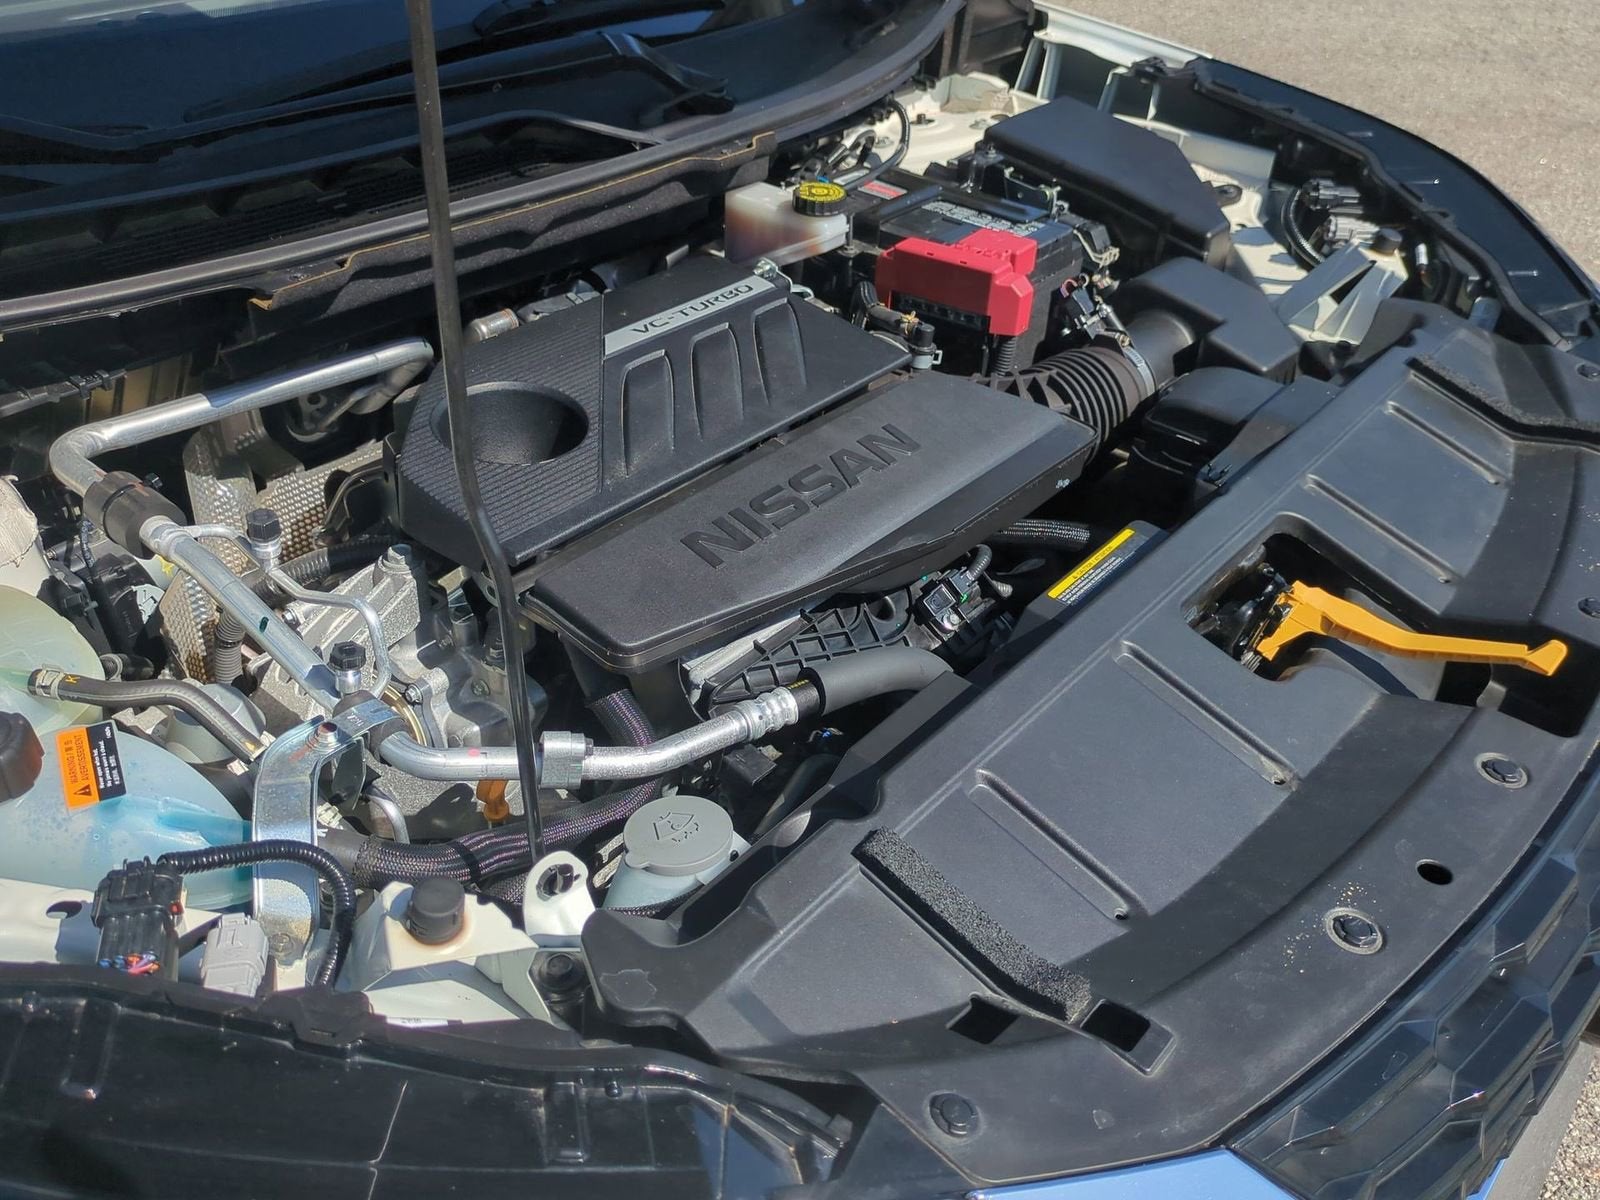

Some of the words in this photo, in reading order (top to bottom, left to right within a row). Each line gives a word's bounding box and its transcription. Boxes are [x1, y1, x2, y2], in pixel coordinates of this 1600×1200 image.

[632, 284, 753, 333] VC-TURBO
[680, 423, 921, 570] NISSAN
[67, 755, 79, 784] WARNING
[74, 735, 89, 781] AVERTISSEMENT
